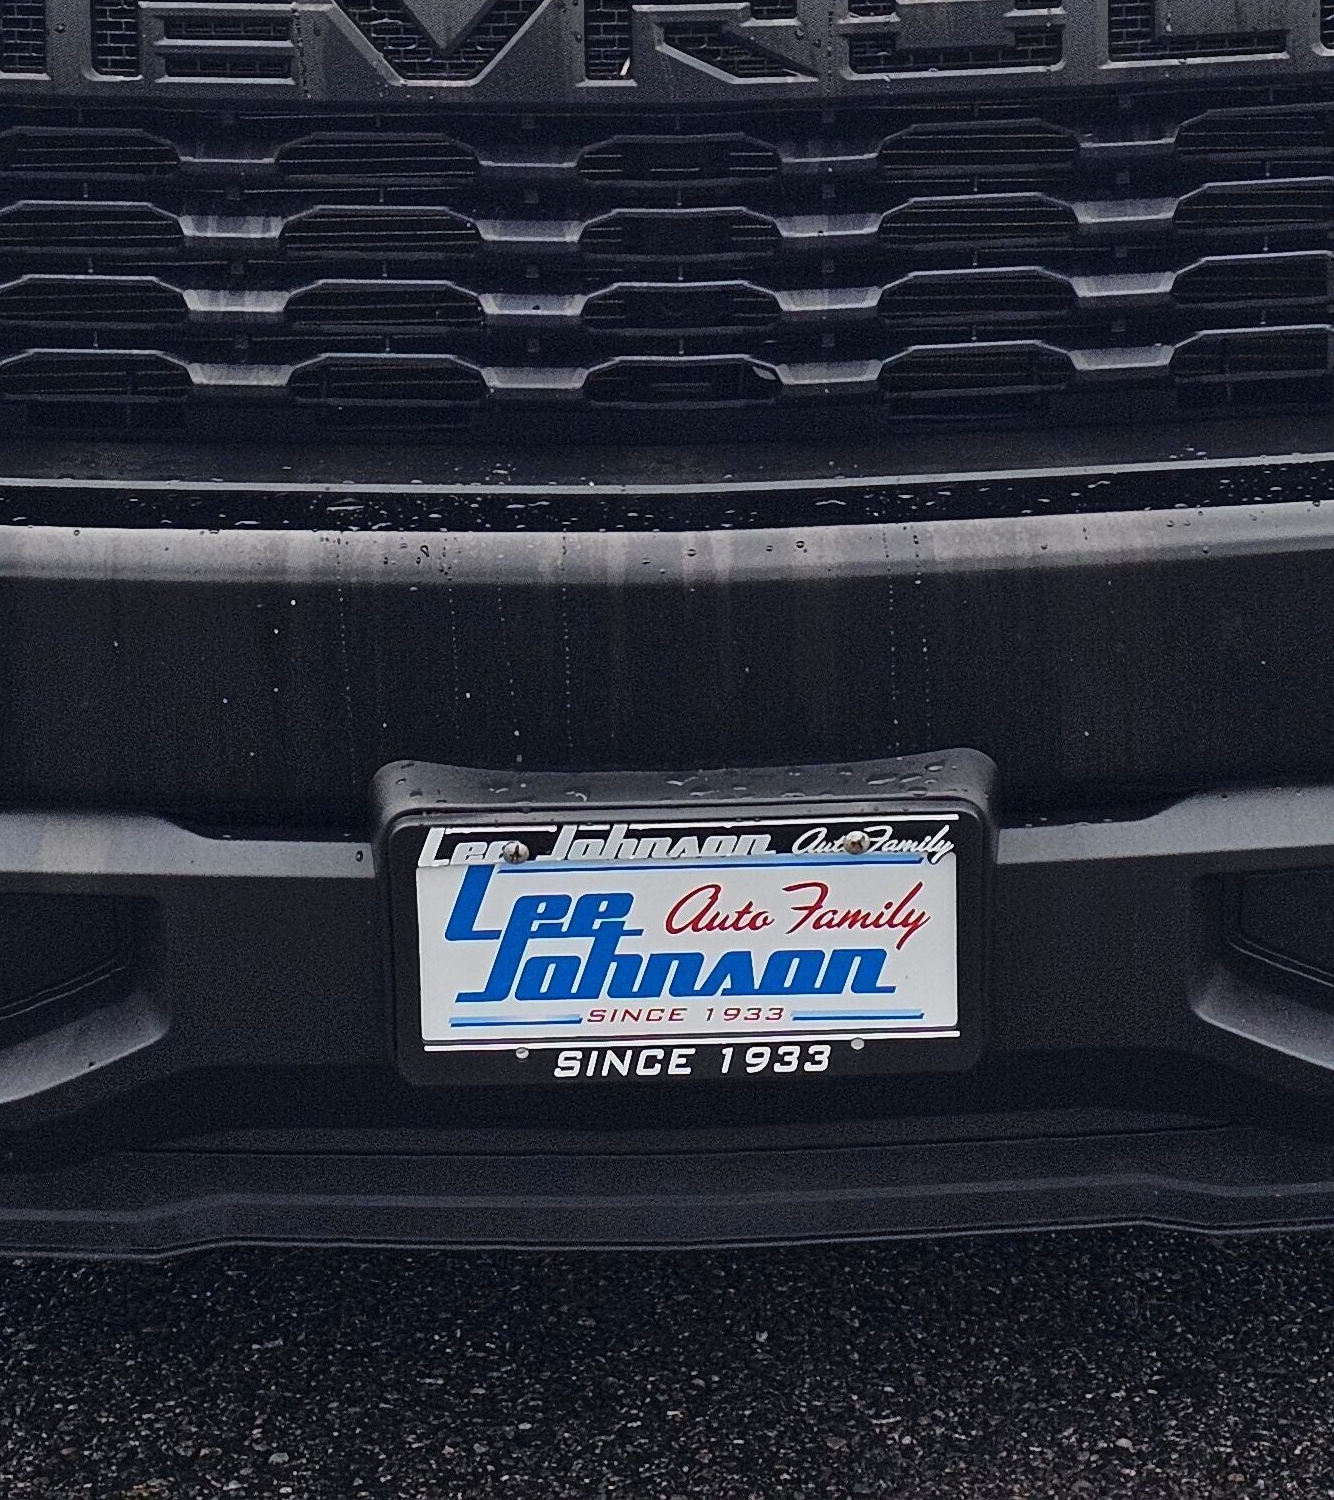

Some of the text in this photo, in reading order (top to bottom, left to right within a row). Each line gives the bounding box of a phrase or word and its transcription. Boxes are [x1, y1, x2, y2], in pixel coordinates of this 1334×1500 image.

[535, 824, 777, 861] Johnson
[791, 827, 869, 855] Aut
[864, 825, 954, 864] Family
[444, 864, 931, 950] Lee Auto Family
[455, 920, 897, 1003] Johnson
[586, 1007, 785, 1023] SINCE 1933
[553, 1044, 832, 1078] SINCE 1933
